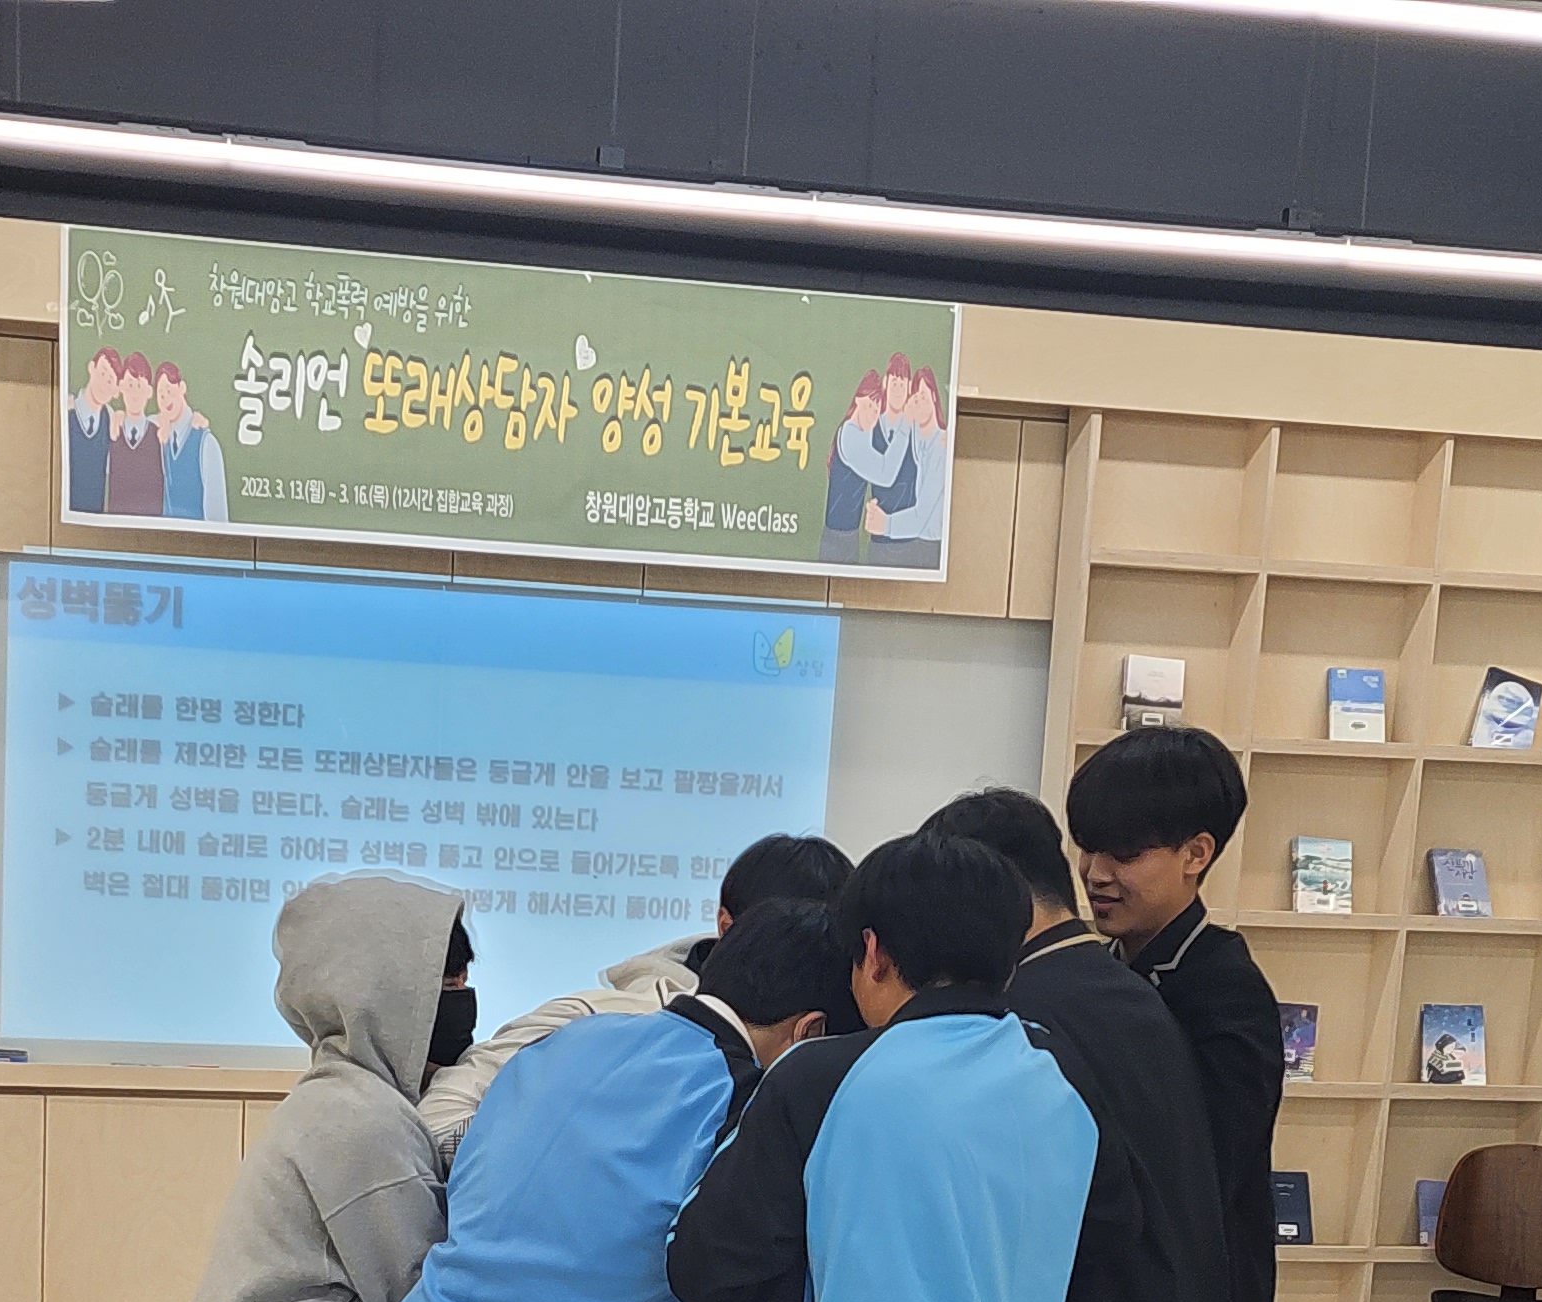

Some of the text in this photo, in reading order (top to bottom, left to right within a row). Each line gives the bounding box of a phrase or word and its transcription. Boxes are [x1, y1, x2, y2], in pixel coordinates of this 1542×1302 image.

[209, 262, 472, 333] 창원대암고 학교폭력 예방을 위한
[233, 333, 815, 470] 솔리언 또래상담자 양성 기본교육
[240, 476, 272, 498] 2023.
[275, 479, 285, 499] 3.
[289, 479, 325, 504] 13.(월)
[339, 484, 349, 504] 3.
[354, 485, 389, 509] 16.(목)
[391, 485, 433, 512] (12시간
[436, 488, 483, 515] 집합교육
[485, 492, 514, 518] 과정)
[585, 490, 798, 533] 창원대암고등학교 WeeClass
[16, 575, 185, 629] 성벽뚫기
[90, 691, 305, 729] 술래를 한명 정한다
[89, 736, 784, 799] 술래를 제외한 모든 또래상담자들은 둥글게 안을 보고 팔짱을껴서
[86, 781, 599, 832] 둥글게 성벽을 만든다. 술래는 성벽 밖에 있는다
[87, 826, 125, 852] 2분
[137, 828, 186, 855] 내에
[197, 832, 268, 859] 술래로
[280, 835, 349, 863] 하여금
[360, 840, 428, 868] 성벽을
[438, 843, 483, 870] 뚫고
[494, 846, 559, 872] 안으로
[571, 850, 680, 879] 들어가도록
[83, 870, 130, 898] 벽은
[142, 872, 189, 900] 절대
[527, 891, 616, 919] 해서든지
[626, 896, 691, 922] 뚫어야
